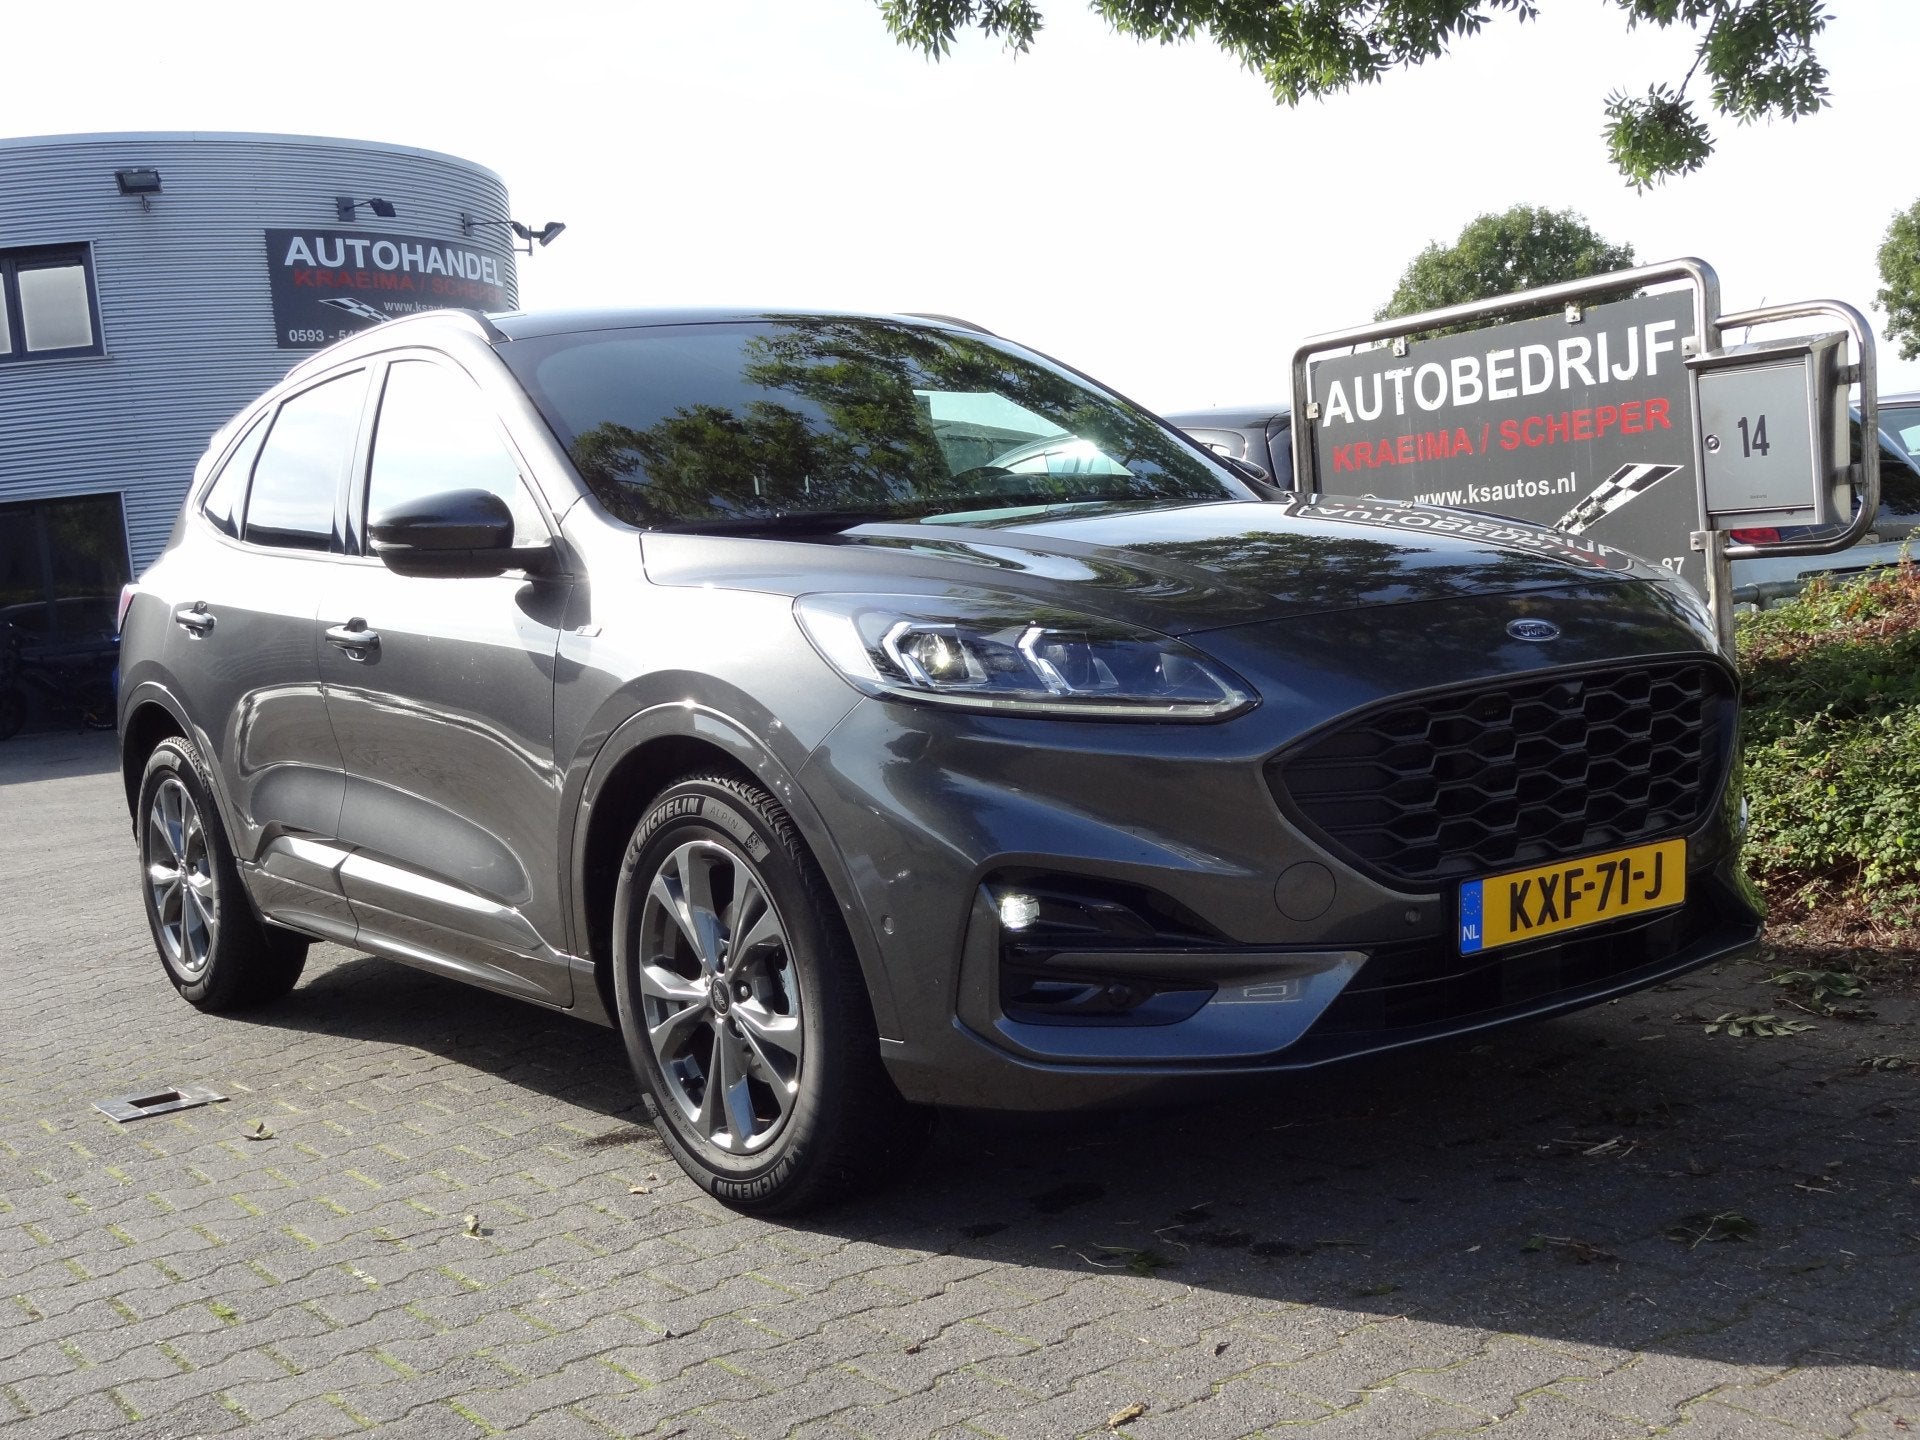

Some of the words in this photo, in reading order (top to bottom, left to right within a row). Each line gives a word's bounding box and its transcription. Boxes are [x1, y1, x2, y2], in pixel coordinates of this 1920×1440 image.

[284, 236, 503, 287] AUTOHANDEL
[294, 269, 414, 291] KRAEIMA
[383, 302, 448, 313] www.ksaut
[288, 329, 325, 342] 0593
[1322, 319, 1677, 428] AUTOBEDRIJF
[1333, 428, 1472, 473] KRAEIMA
[1480, 422, 1489, 455] /
[1499, 396, 1673, 451] SCHEPER
[1737, 414, 1770, 458] 14
[1414, 472, 1576, 506] www.ksautos.nl
[636, 797, 699, 849] MICHELIN
[1509, 851, 1663, 933] KXF-71-J
[1462, 924, 1480, 942] NL
[716, 1162, 790, 1199] MICHELIN
